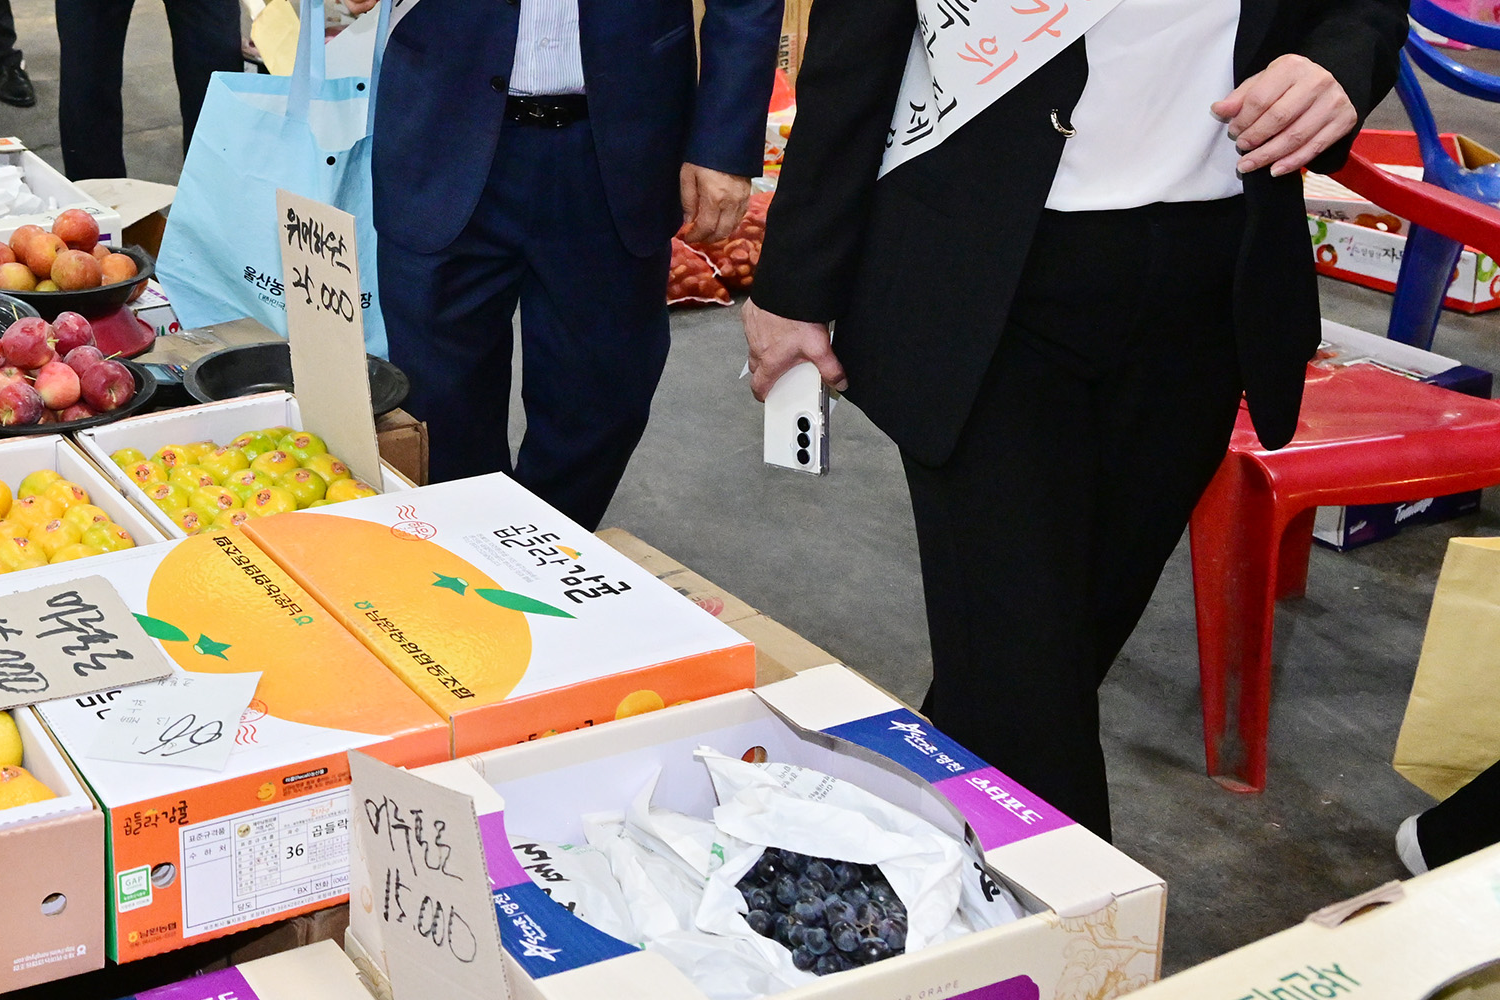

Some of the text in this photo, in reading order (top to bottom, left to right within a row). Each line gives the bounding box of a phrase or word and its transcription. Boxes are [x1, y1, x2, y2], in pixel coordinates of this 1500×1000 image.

[367, 609, 476, 701] 남원농업협동조합
[936, 752, 966, 774] 영천
[162, 800, 190, 826] 감귤
[286, 844, 304, 860] 36
[125, 875, 143, 888] GAP
[918, 979, 960, 1000] GRAPE
